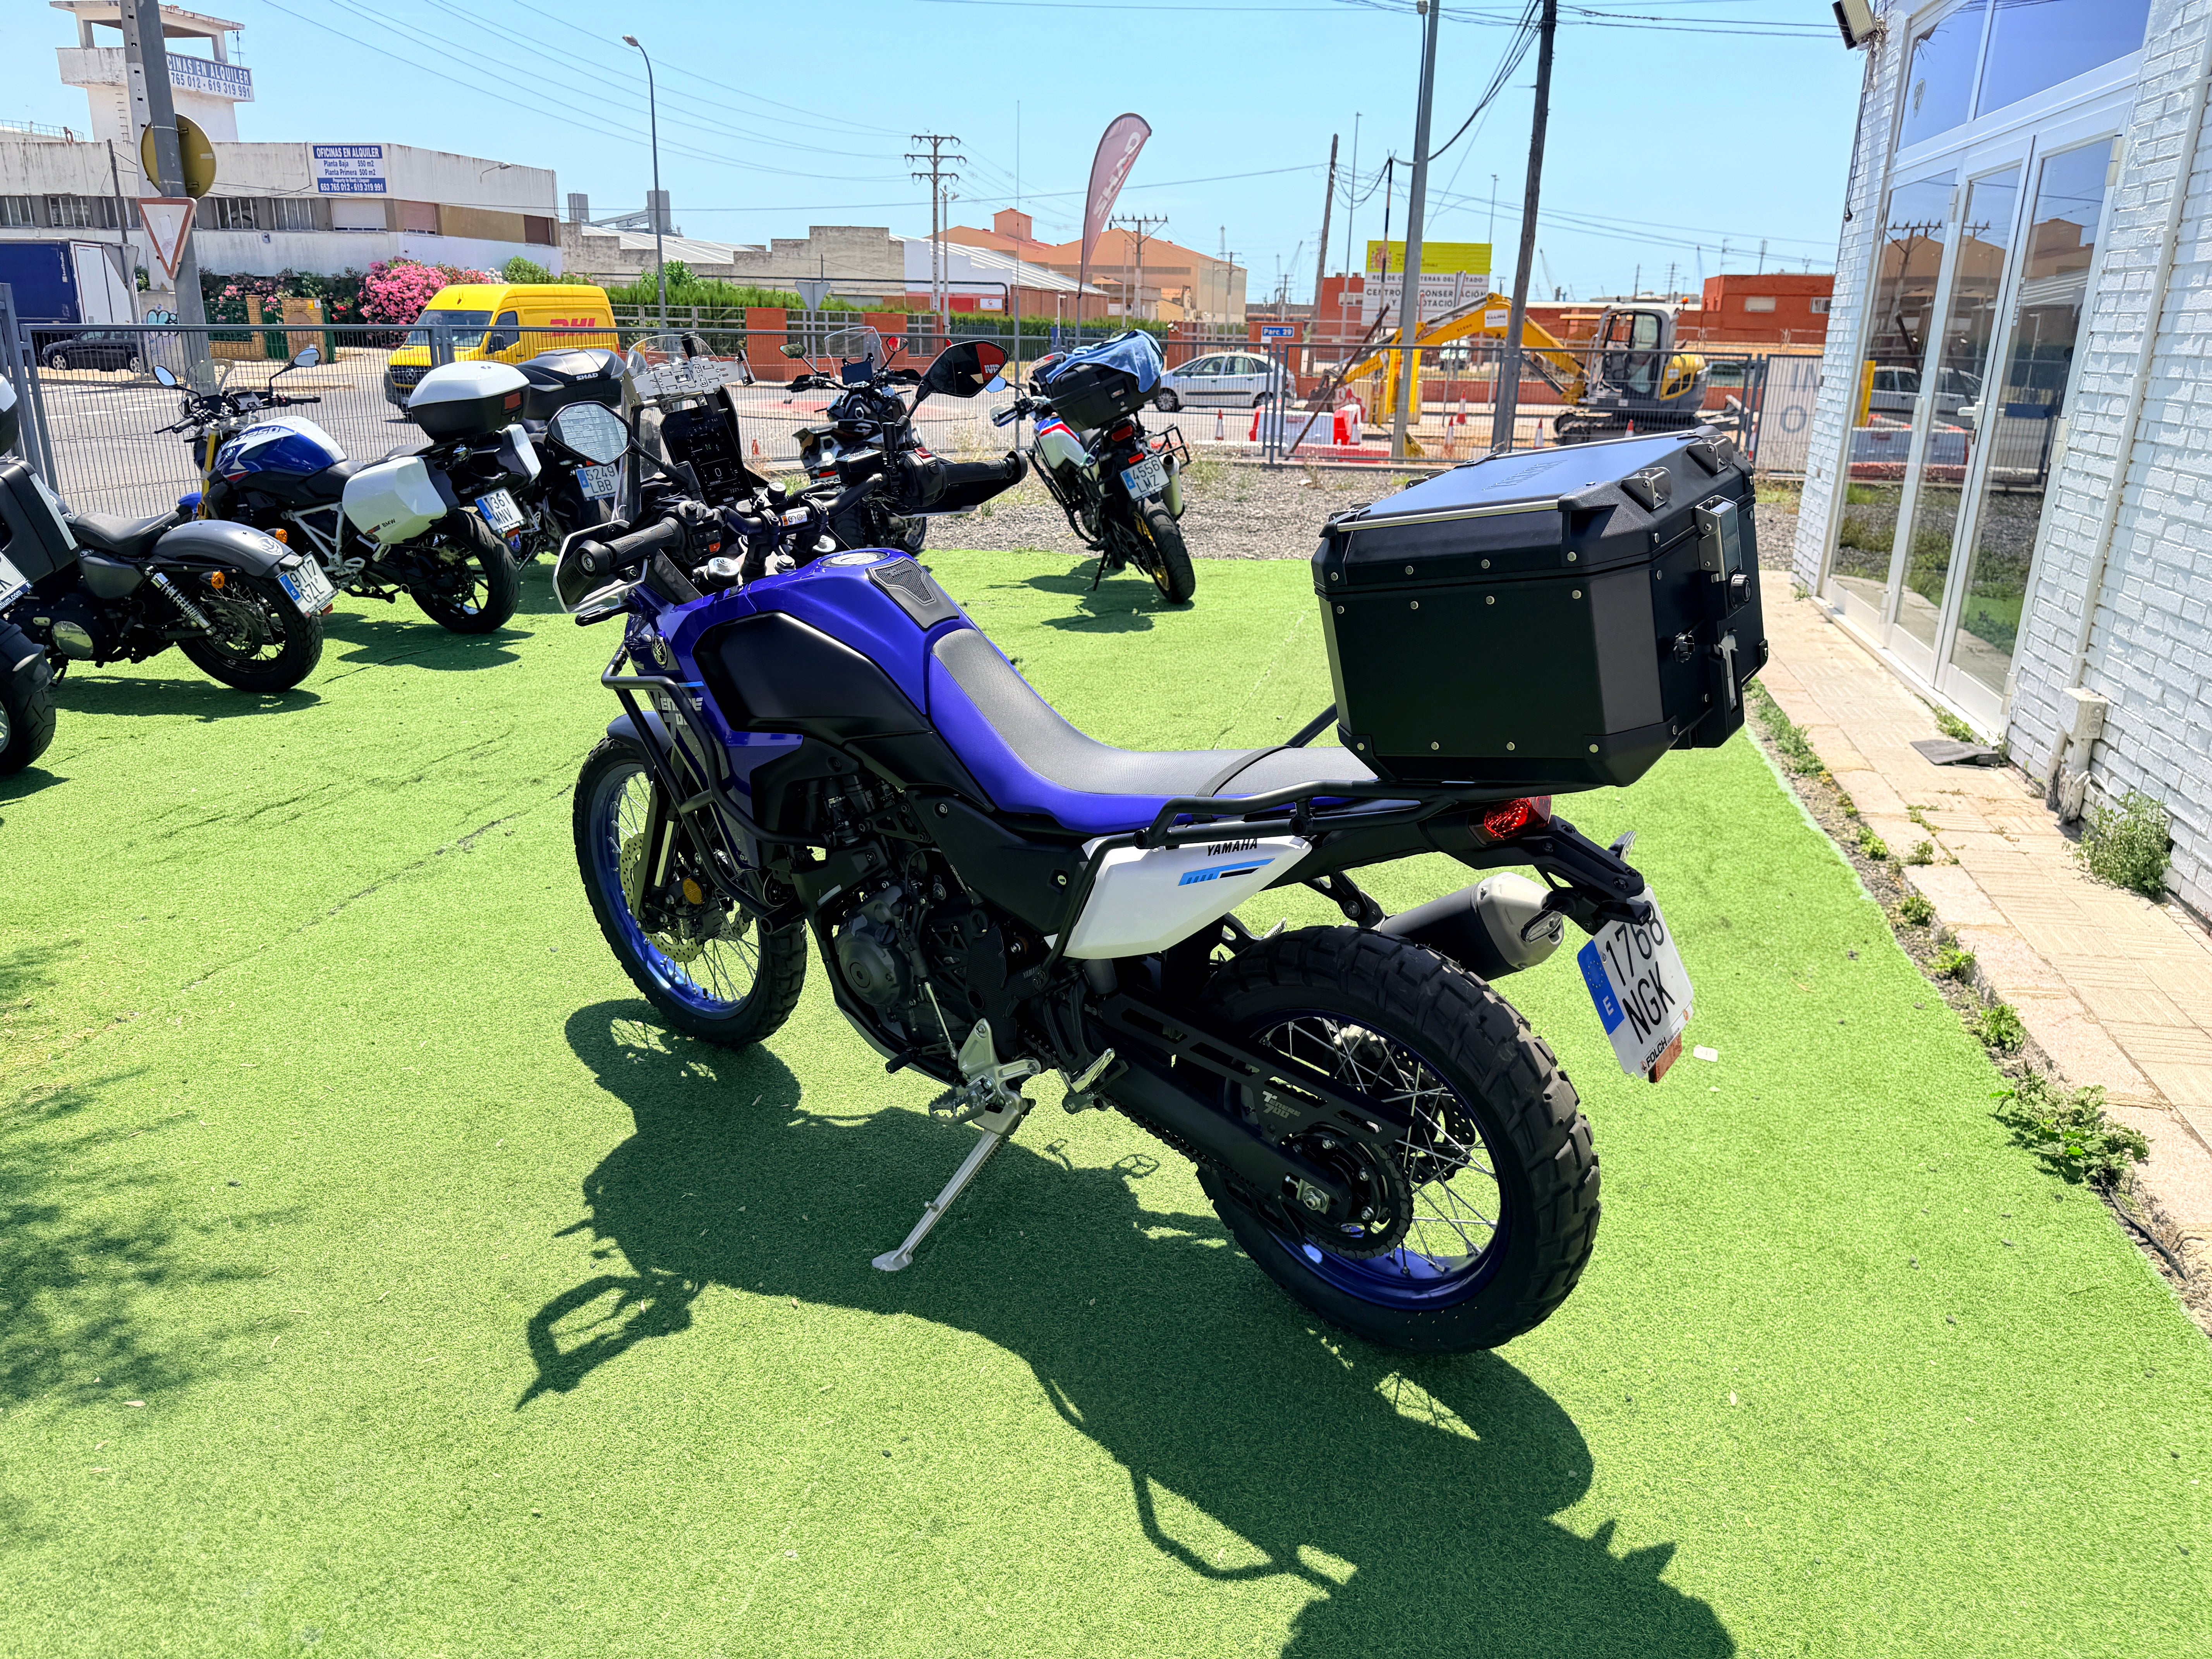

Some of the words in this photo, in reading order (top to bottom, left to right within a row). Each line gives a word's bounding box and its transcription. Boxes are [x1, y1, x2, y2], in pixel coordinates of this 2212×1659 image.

[195, 61, 207, 76] EN
[210, 64, 249, 85] ALQUILER
[171, 72, 185, 86] 765
[187, 75, 201, 89] 012
[208, 79, 221, 93] 619
[223, 82, 236, 95] 319
[238, 85, 251, 98] 991
[316, 147, 342, 158] OFICINAS
[343, 147, 351, 158] EN
[352, 147, 380, 158] ALQUILER
[339, 160, 349, 168] Baja
[320, 183, 330, 191] 653
[330, 183, 340, 191] 765
[340, 183, 350, 191] 012
[354, 183, 363, 191] 619
[364, 183, 374, 191] 319
[374, 183, 384, 191] 991
[549, 318, 599, 337] DHL
[576, 373, 598, 381] SHAD
[585, 465, 615, 481] 5249
[1132, 460, 1160, 480] 4556
[590, 479, 613, 494] LBB
[1136, 474, 1160, 493] LMZ
[484, 492, 510, 512] 1361
[381, 518, 396, 527] BMW
[492, 507, 513, 526] MNV
[289, 559, 317, 588] 9117
[300, 581, 325, 603] GZL
[1207, 838, 1257, 856] YAMAHA
[1605, 900, 1664, 987] 1768
[1602, 995, 1614, 1017] E
[1622, 960, 1676, 1045] NGK
[1646, 1036, 1667, 1068] FOLCH
[1263, 1102, 1290, 1119] 700
